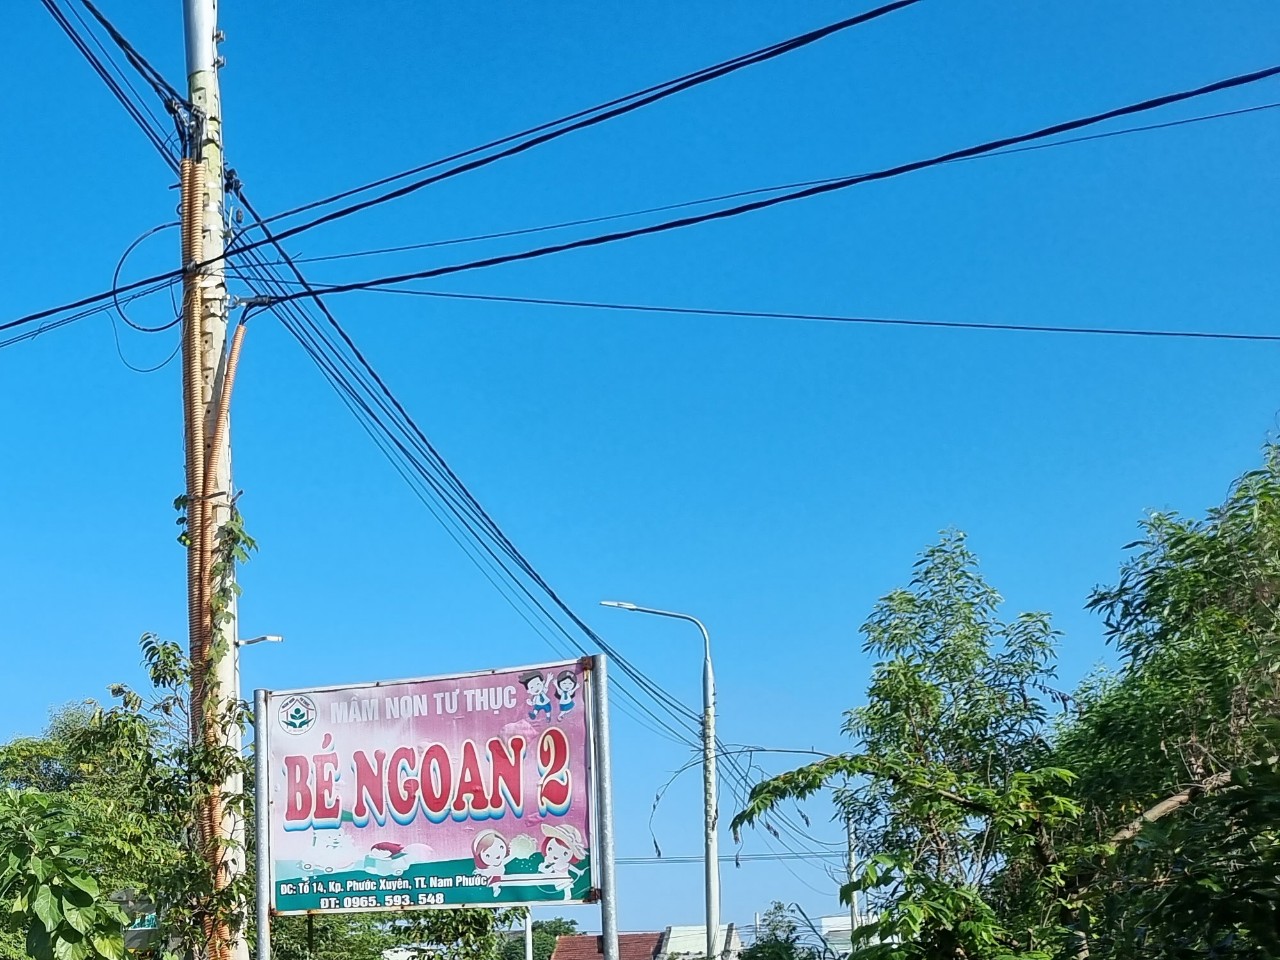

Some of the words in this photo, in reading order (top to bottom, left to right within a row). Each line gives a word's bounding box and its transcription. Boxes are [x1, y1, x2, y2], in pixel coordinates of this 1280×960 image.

[433, 688, 459, 715] TƯ
[464, 686, 517, 715] THỤC
[283, 732, 342, 830] BÉ
[351, 736, 526, 828] NGOAN
[538, 727, 574, 818] 2
[280, 883, 297, 895] ĐC:
[312, 882, 327, 894] 14,
[328, 881, 344, 893] Kp.
[346, 879, 377, 892] Phước
[379, 878, 412, 890] Xuyên,
[429, 876, 453, 888] Nam
[455, 874, 488, 887] Phước
[320, 897, 340, 909] ĐT:
[343, 896, 380, 908] 0965.
[384, 894, 415, 906] 593.
[418, 893, 445, 905] 548
